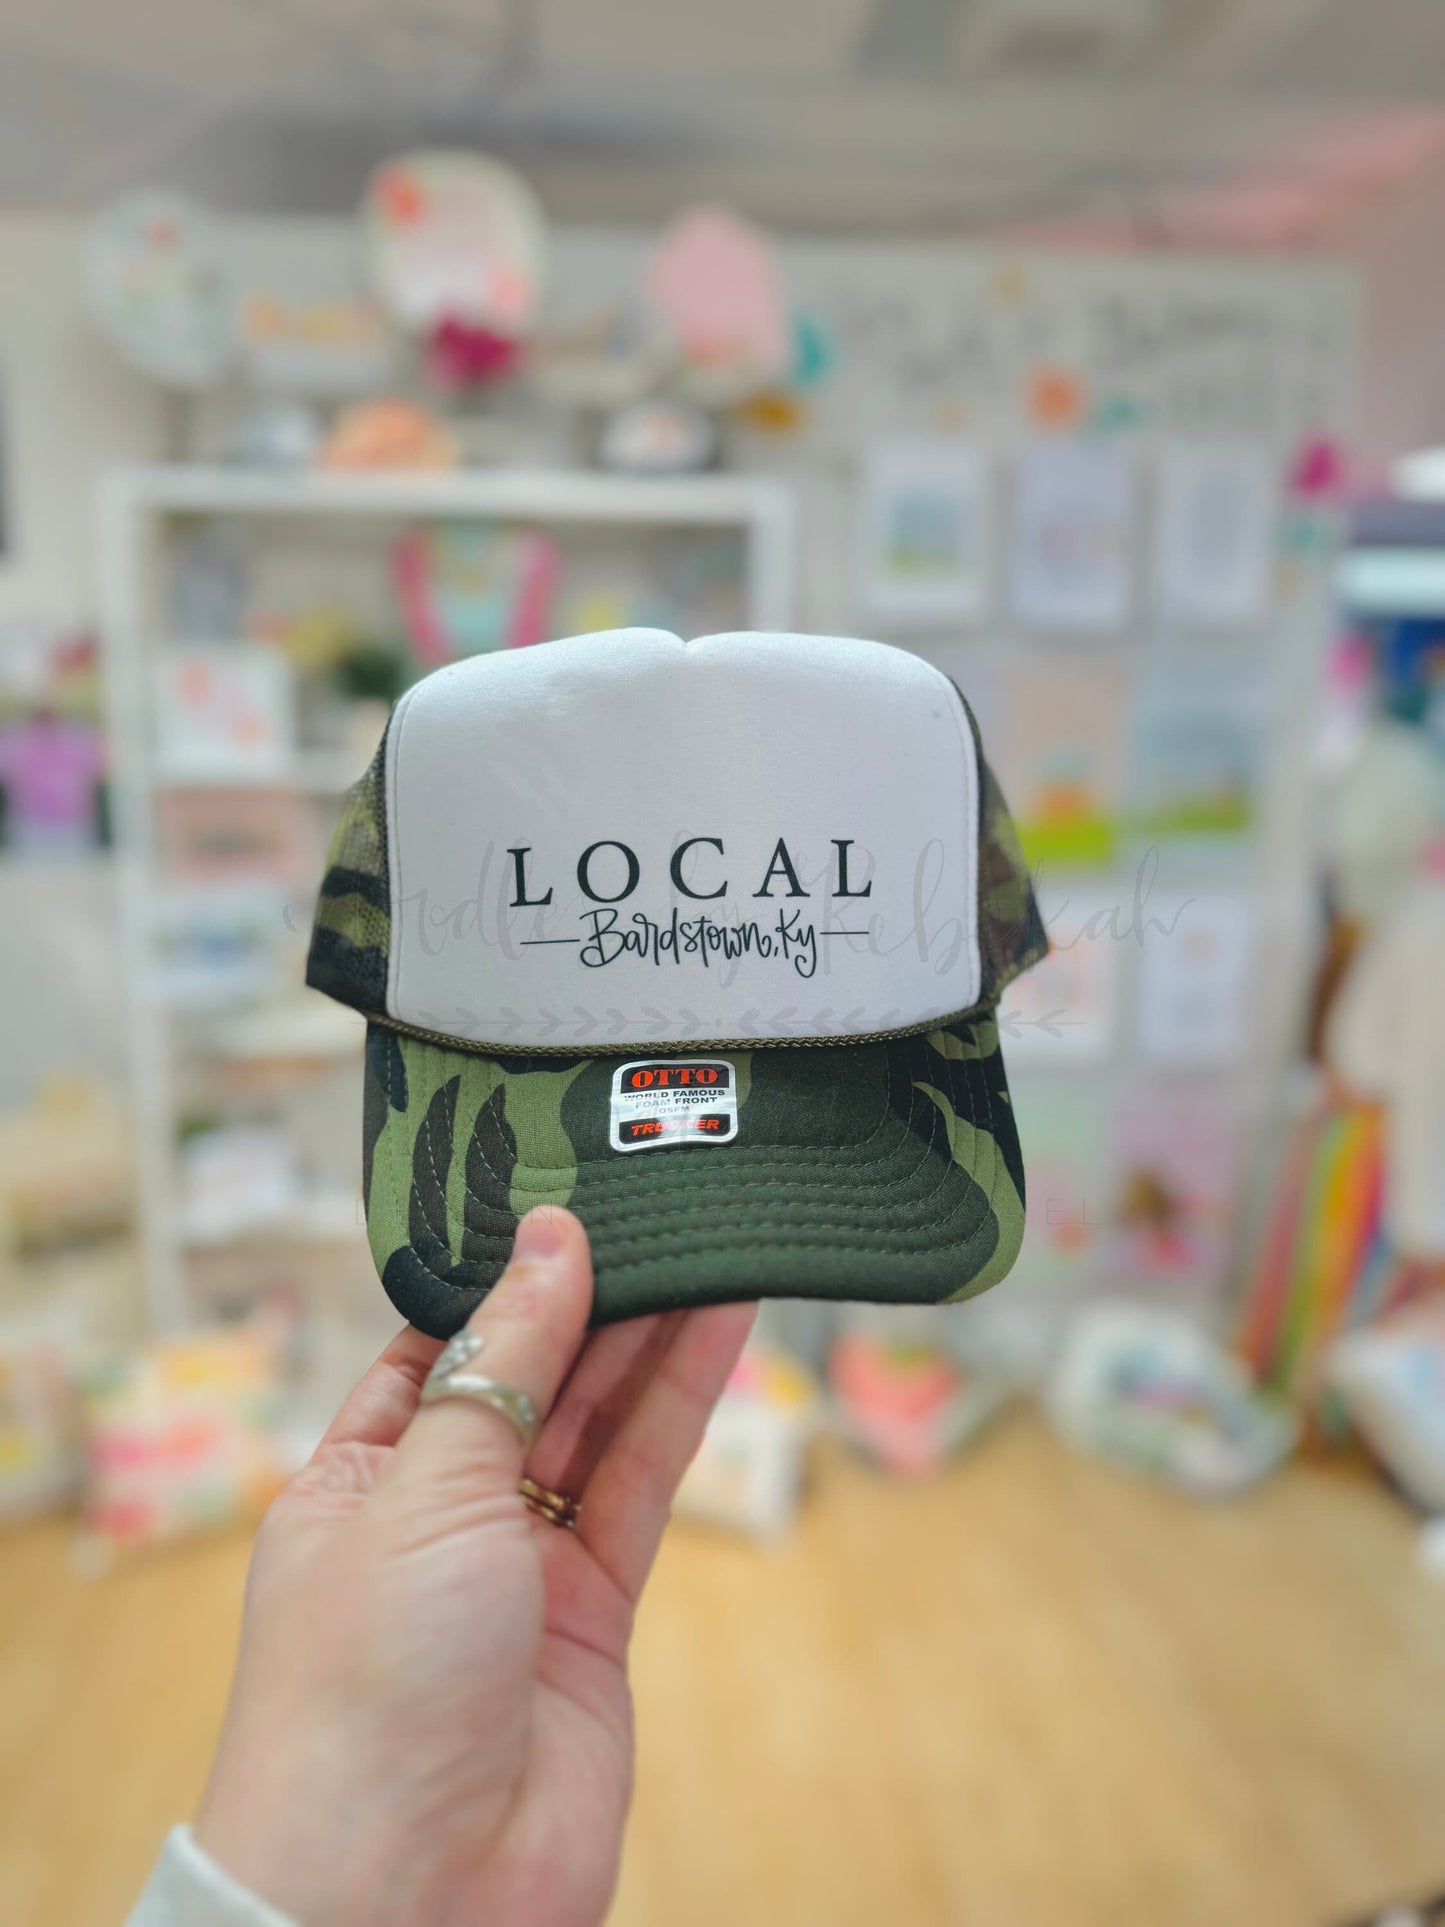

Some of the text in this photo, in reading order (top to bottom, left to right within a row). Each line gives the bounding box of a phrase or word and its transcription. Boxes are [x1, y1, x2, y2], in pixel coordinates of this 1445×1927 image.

[506, 837, 873, 908] LOCAL
[631, 1068, 719, 1089] OTTO
[672, 1089, 726, 1098] FAMOUS
[674, 1096, 718, 1105] FRONT
